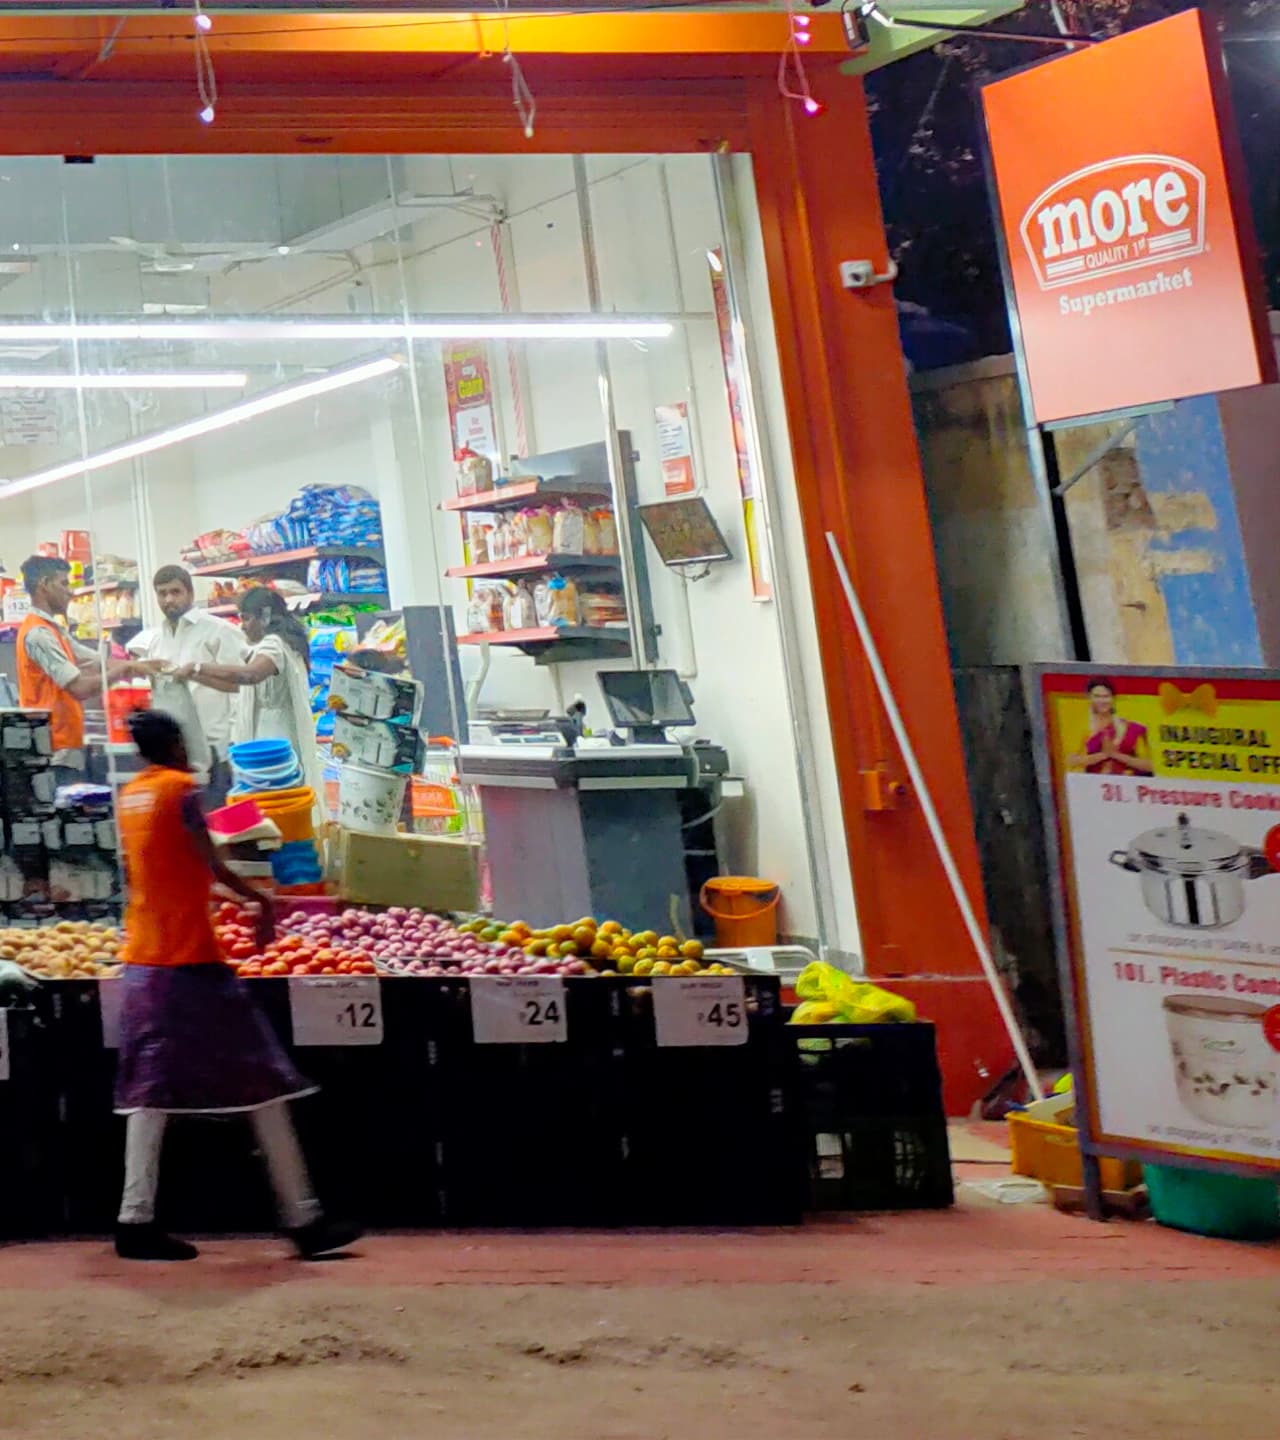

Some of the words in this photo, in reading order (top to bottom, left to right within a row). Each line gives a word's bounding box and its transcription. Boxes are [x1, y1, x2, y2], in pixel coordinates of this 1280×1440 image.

[1037, 170, 1190, 259] more
[1086, 244, 1129, 268] QUALITY
[1058, 267, 1193, 316] Supermarket
[1159, 724, 1272, 748] INAUGURAL
[1162, 749, 1243, 772] SPECIAL
[1137, 785, 1223, 809] Pressure
[1160, 965, 1227, 991] Plastic
